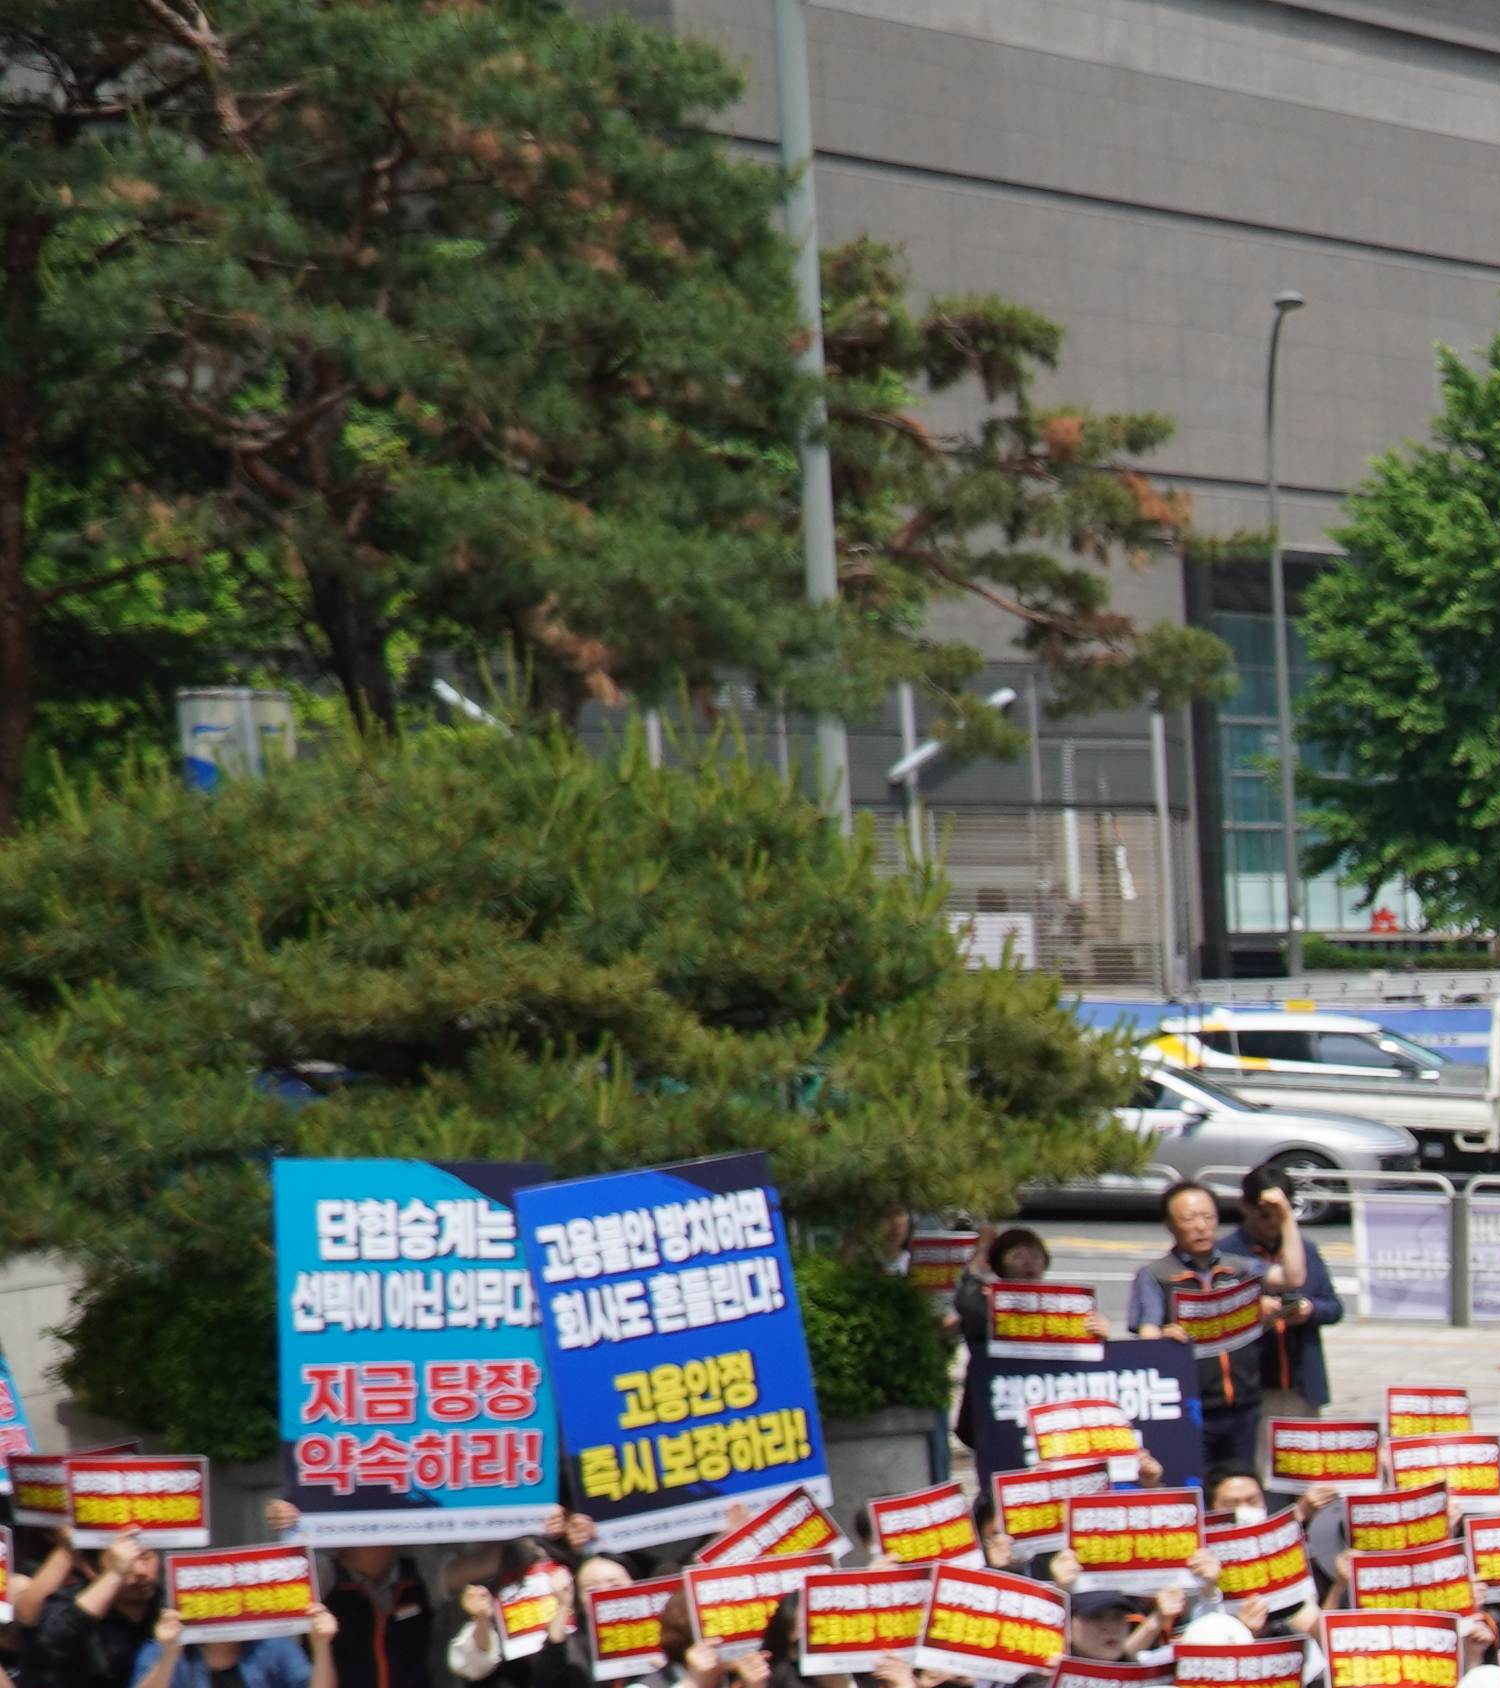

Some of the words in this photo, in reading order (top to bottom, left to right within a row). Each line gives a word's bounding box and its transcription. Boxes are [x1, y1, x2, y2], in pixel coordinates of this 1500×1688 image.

[317, 1198, 516, 1260] 단협승계는
[537, 1207, 659, 1283] 고용불안
[655, 1188, 775, 1263] 방치하면
[292, 1269, 381, 1332] 선택이
[387, 1271, 443, 1330] 아닌
[552, 1283, 653, 1350] 회사도
[652, 1257, 785, 1333] 흔들린다!
[301, 1363, 415, 1424] 지금
[425, 1360, 541, 1421] 당장
[614, 1350, 758, 1430] 고용안정
[296, 1429, 544, 1495] 약속하라!
[581, 1439, 658, 1500] 즉시
[659, 1409, 809, 1489] 보장하라!
